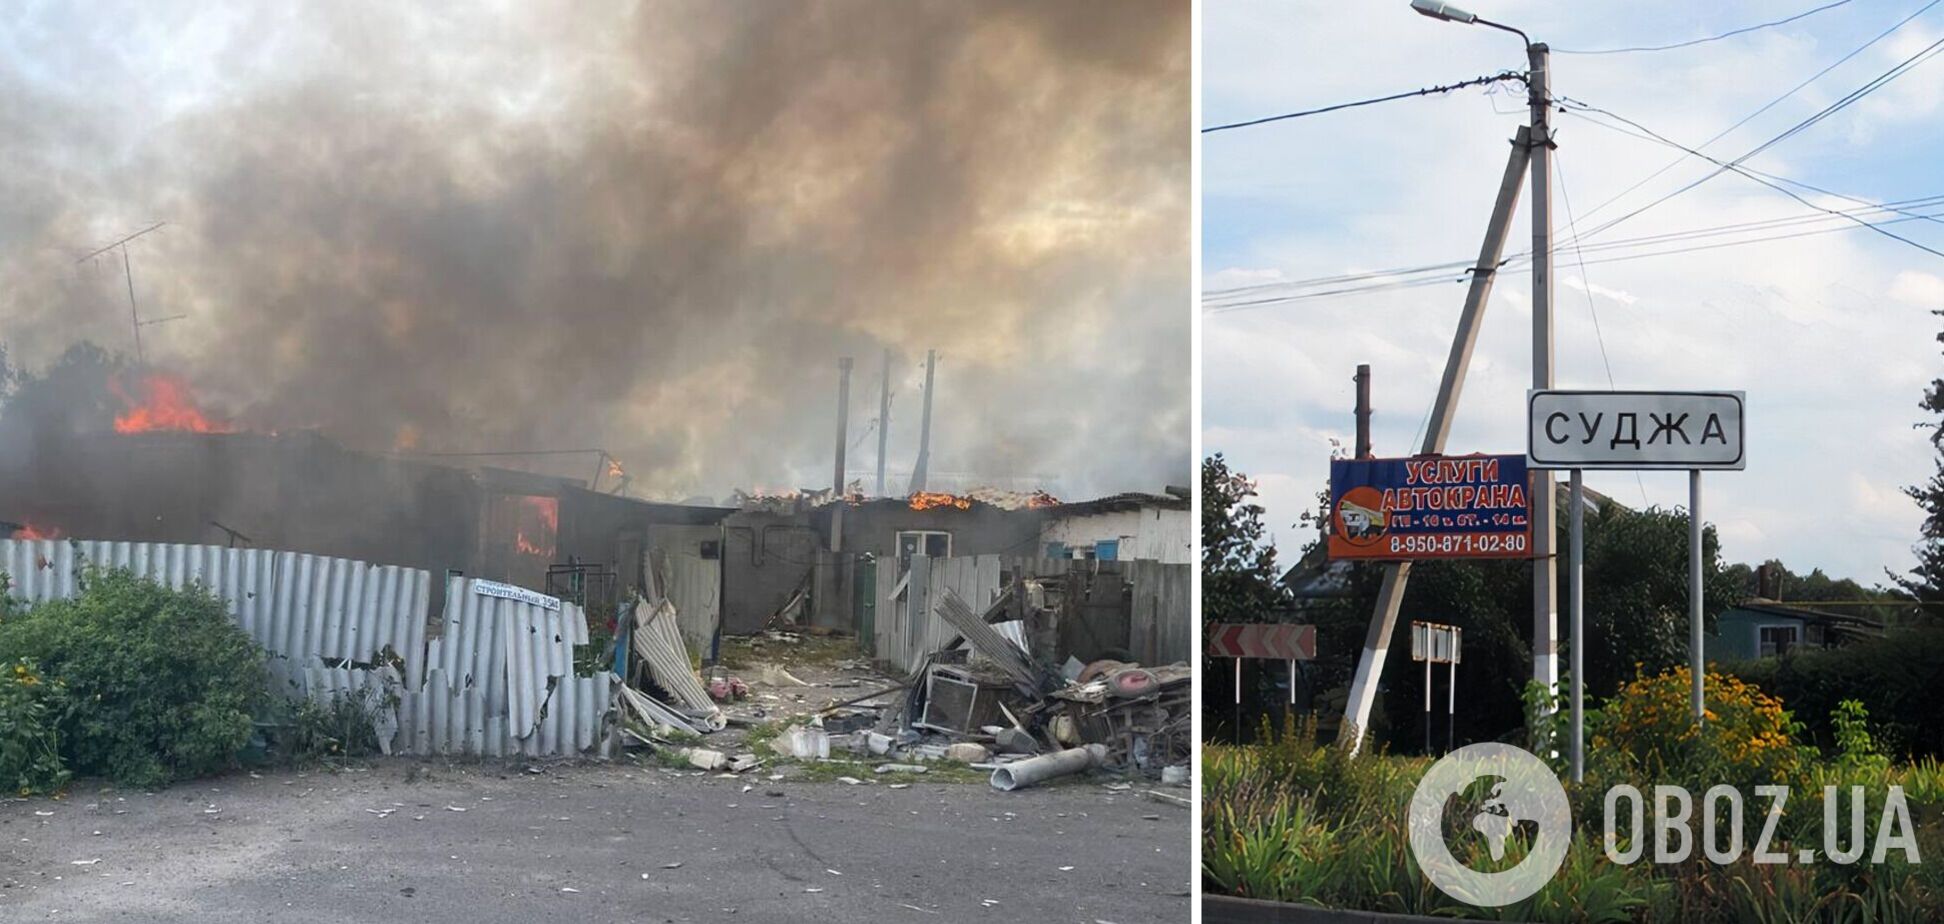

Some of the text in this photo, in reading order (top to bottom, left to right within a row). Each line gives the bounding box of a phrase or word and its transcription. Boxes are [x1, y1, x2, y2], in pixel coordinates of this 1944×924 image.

[1545, 411, 1727, 450] СУДЖА
[1405, 458, 1499, 485] УСЛУГИ
[1380, 484, 1527, 512] АВТОКРАНА
[1391, 534, 1526, 553] 8-950-871-02-80
